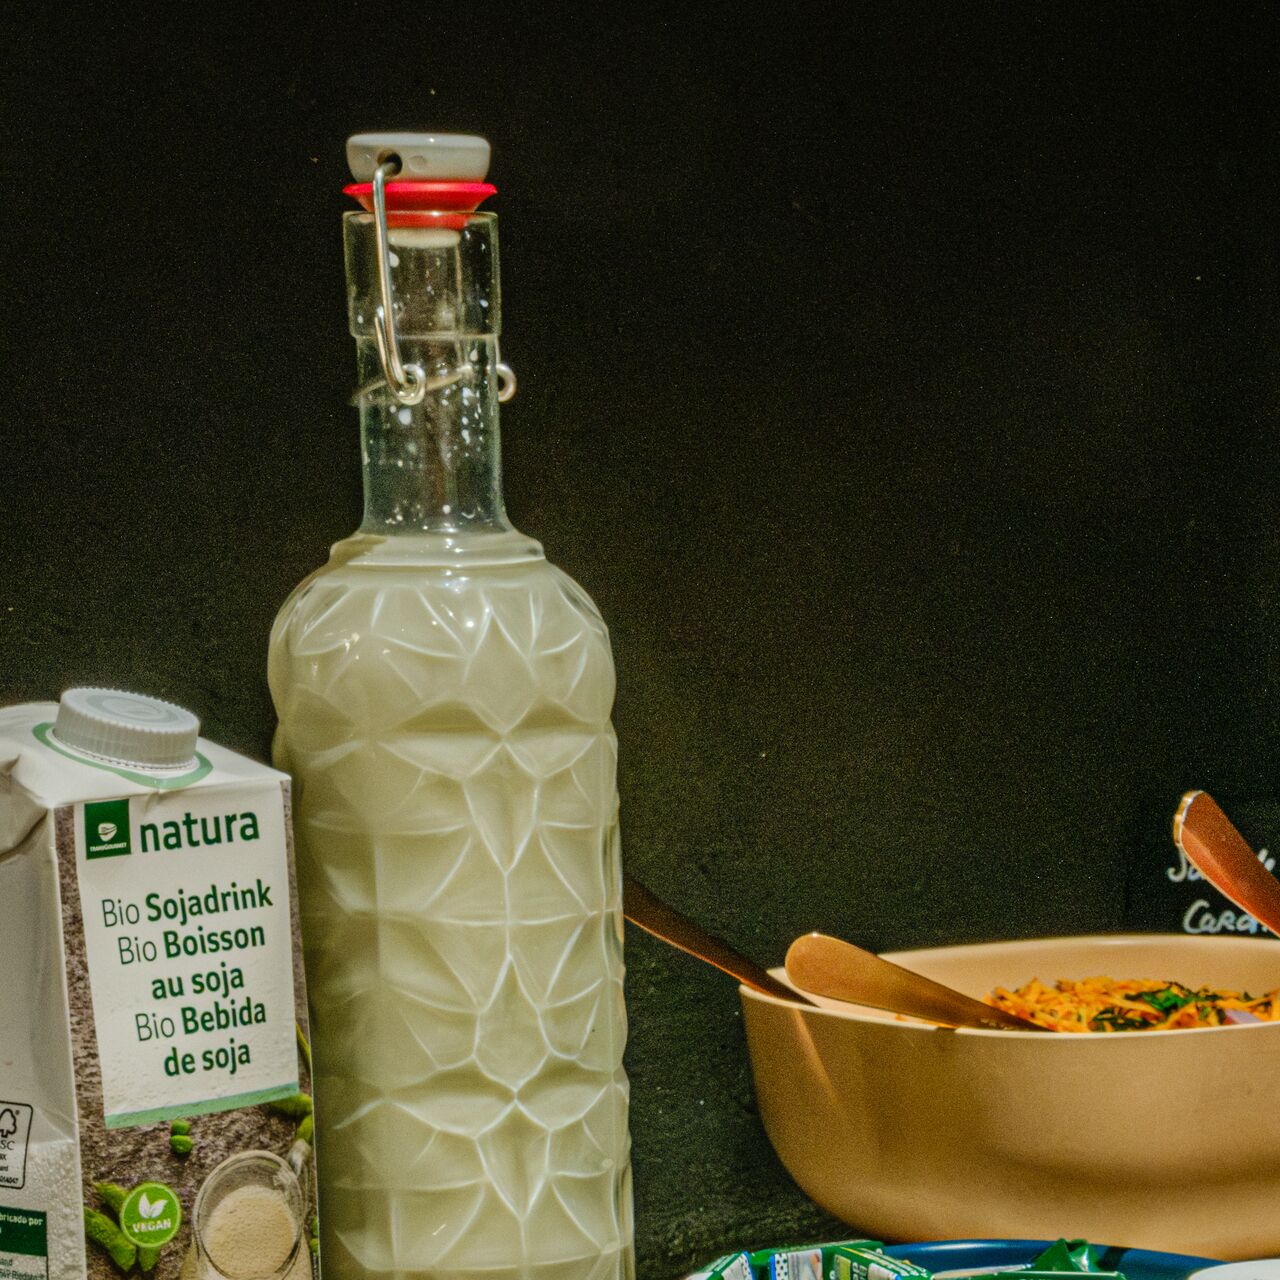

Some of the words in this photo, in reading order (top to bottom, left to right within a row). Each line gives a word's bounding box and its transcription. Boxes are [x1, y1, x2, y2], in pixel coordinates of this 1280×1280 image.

[140, 811, 260, 853] natura
[102, 899, 141, 928] Bio
[146, 878, 274, 927] Sojadrink
[118, 936, 158, 965] Bio
[163, 923, 266, 959] Boisson
[151, 974, 185, 1000] au
[191, 961, 245, 999] soja
[135, 1013, 176, 1042] Bio
[180, 996, 267, 1035] Bebida
[164, 1046, 196, 1077] de
[202, 1042, 251, 1076] soja
[0, 1139, 16, 1151] SC
[132, 1217, 172, 1234] VEGAN
